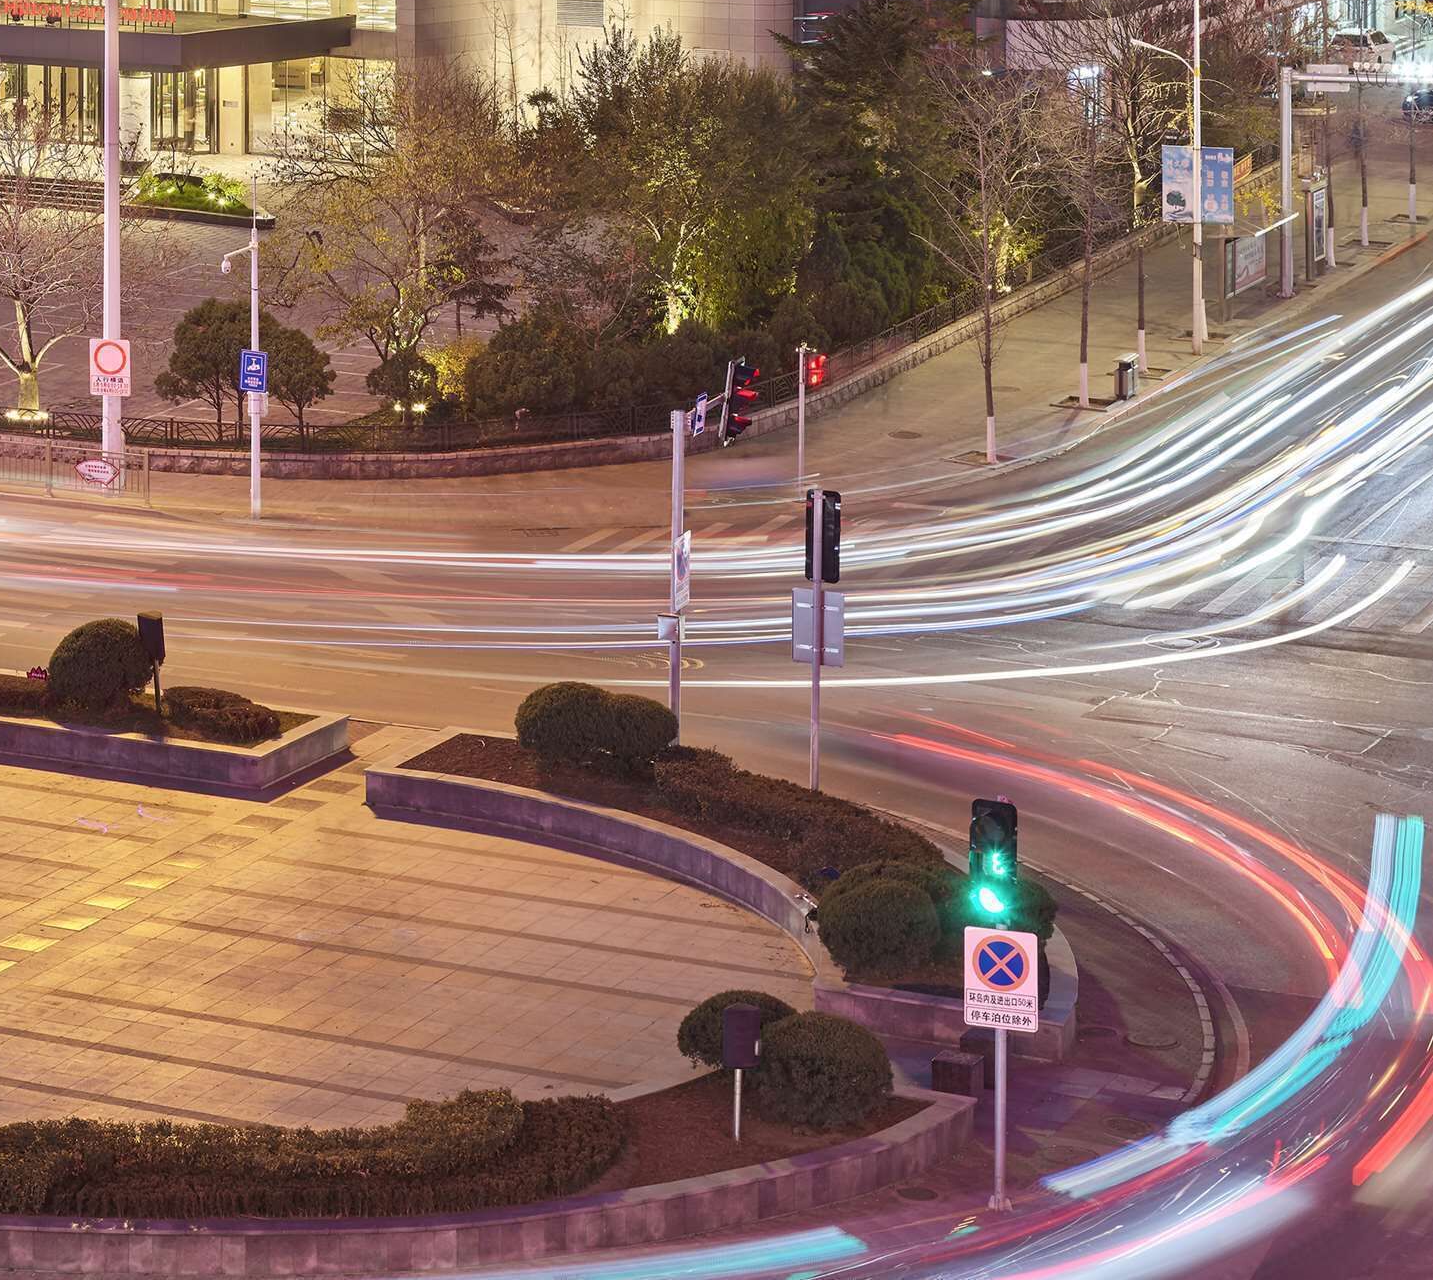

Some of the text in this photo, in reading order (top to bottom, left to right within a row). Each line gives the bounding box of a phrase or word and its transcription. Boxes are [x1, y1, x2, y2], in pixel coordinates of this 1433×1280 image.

[969, 992, 1033, 1009] 环岛内及进出口50米
[970, 1009, 1032, 1027] 停车泊位除外
